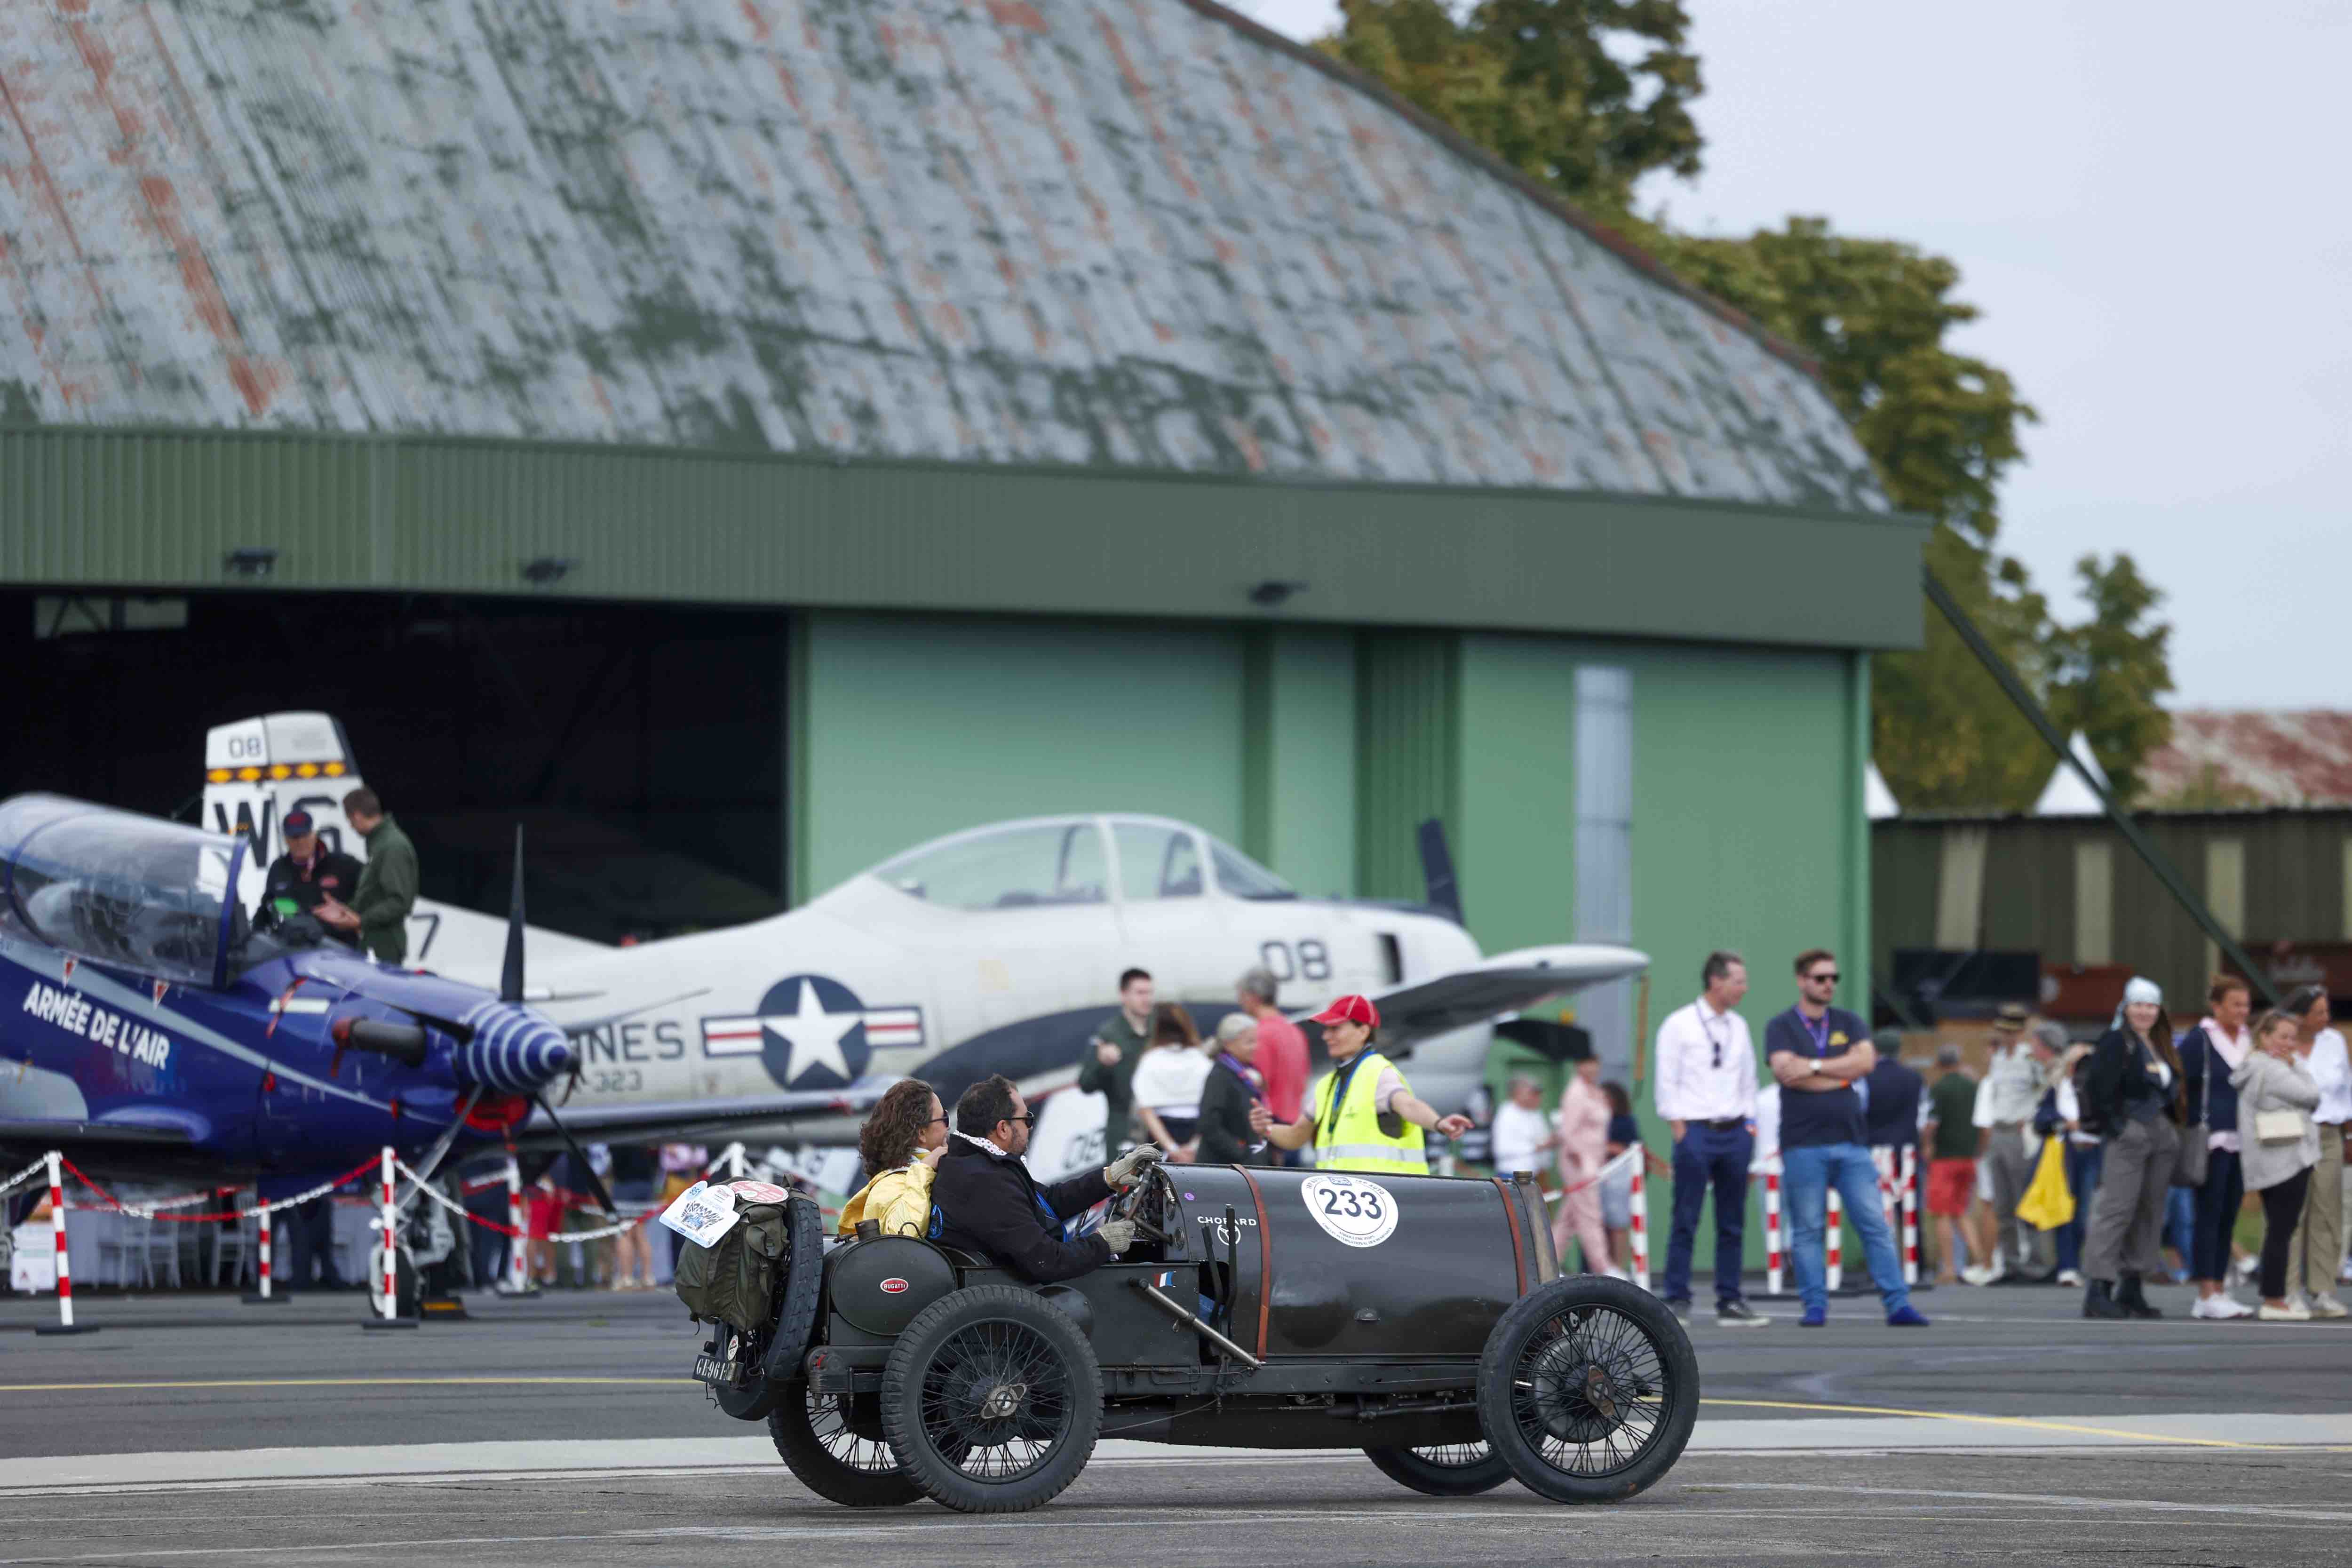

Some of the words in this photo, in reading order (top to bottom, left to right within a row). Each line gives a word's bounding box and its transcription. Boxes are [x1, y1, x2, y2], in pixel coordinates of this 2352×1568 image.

[229, 736, 262, 758] 08
[1259, 939, 1334, 982] 08
[23, 980, 92, 1036] ARMÉE
[89, 1007, 120, 1049] DE
[118, 1020, 171, 1071] L'AIR
[1319, 1188, 1382, 1219] 233
